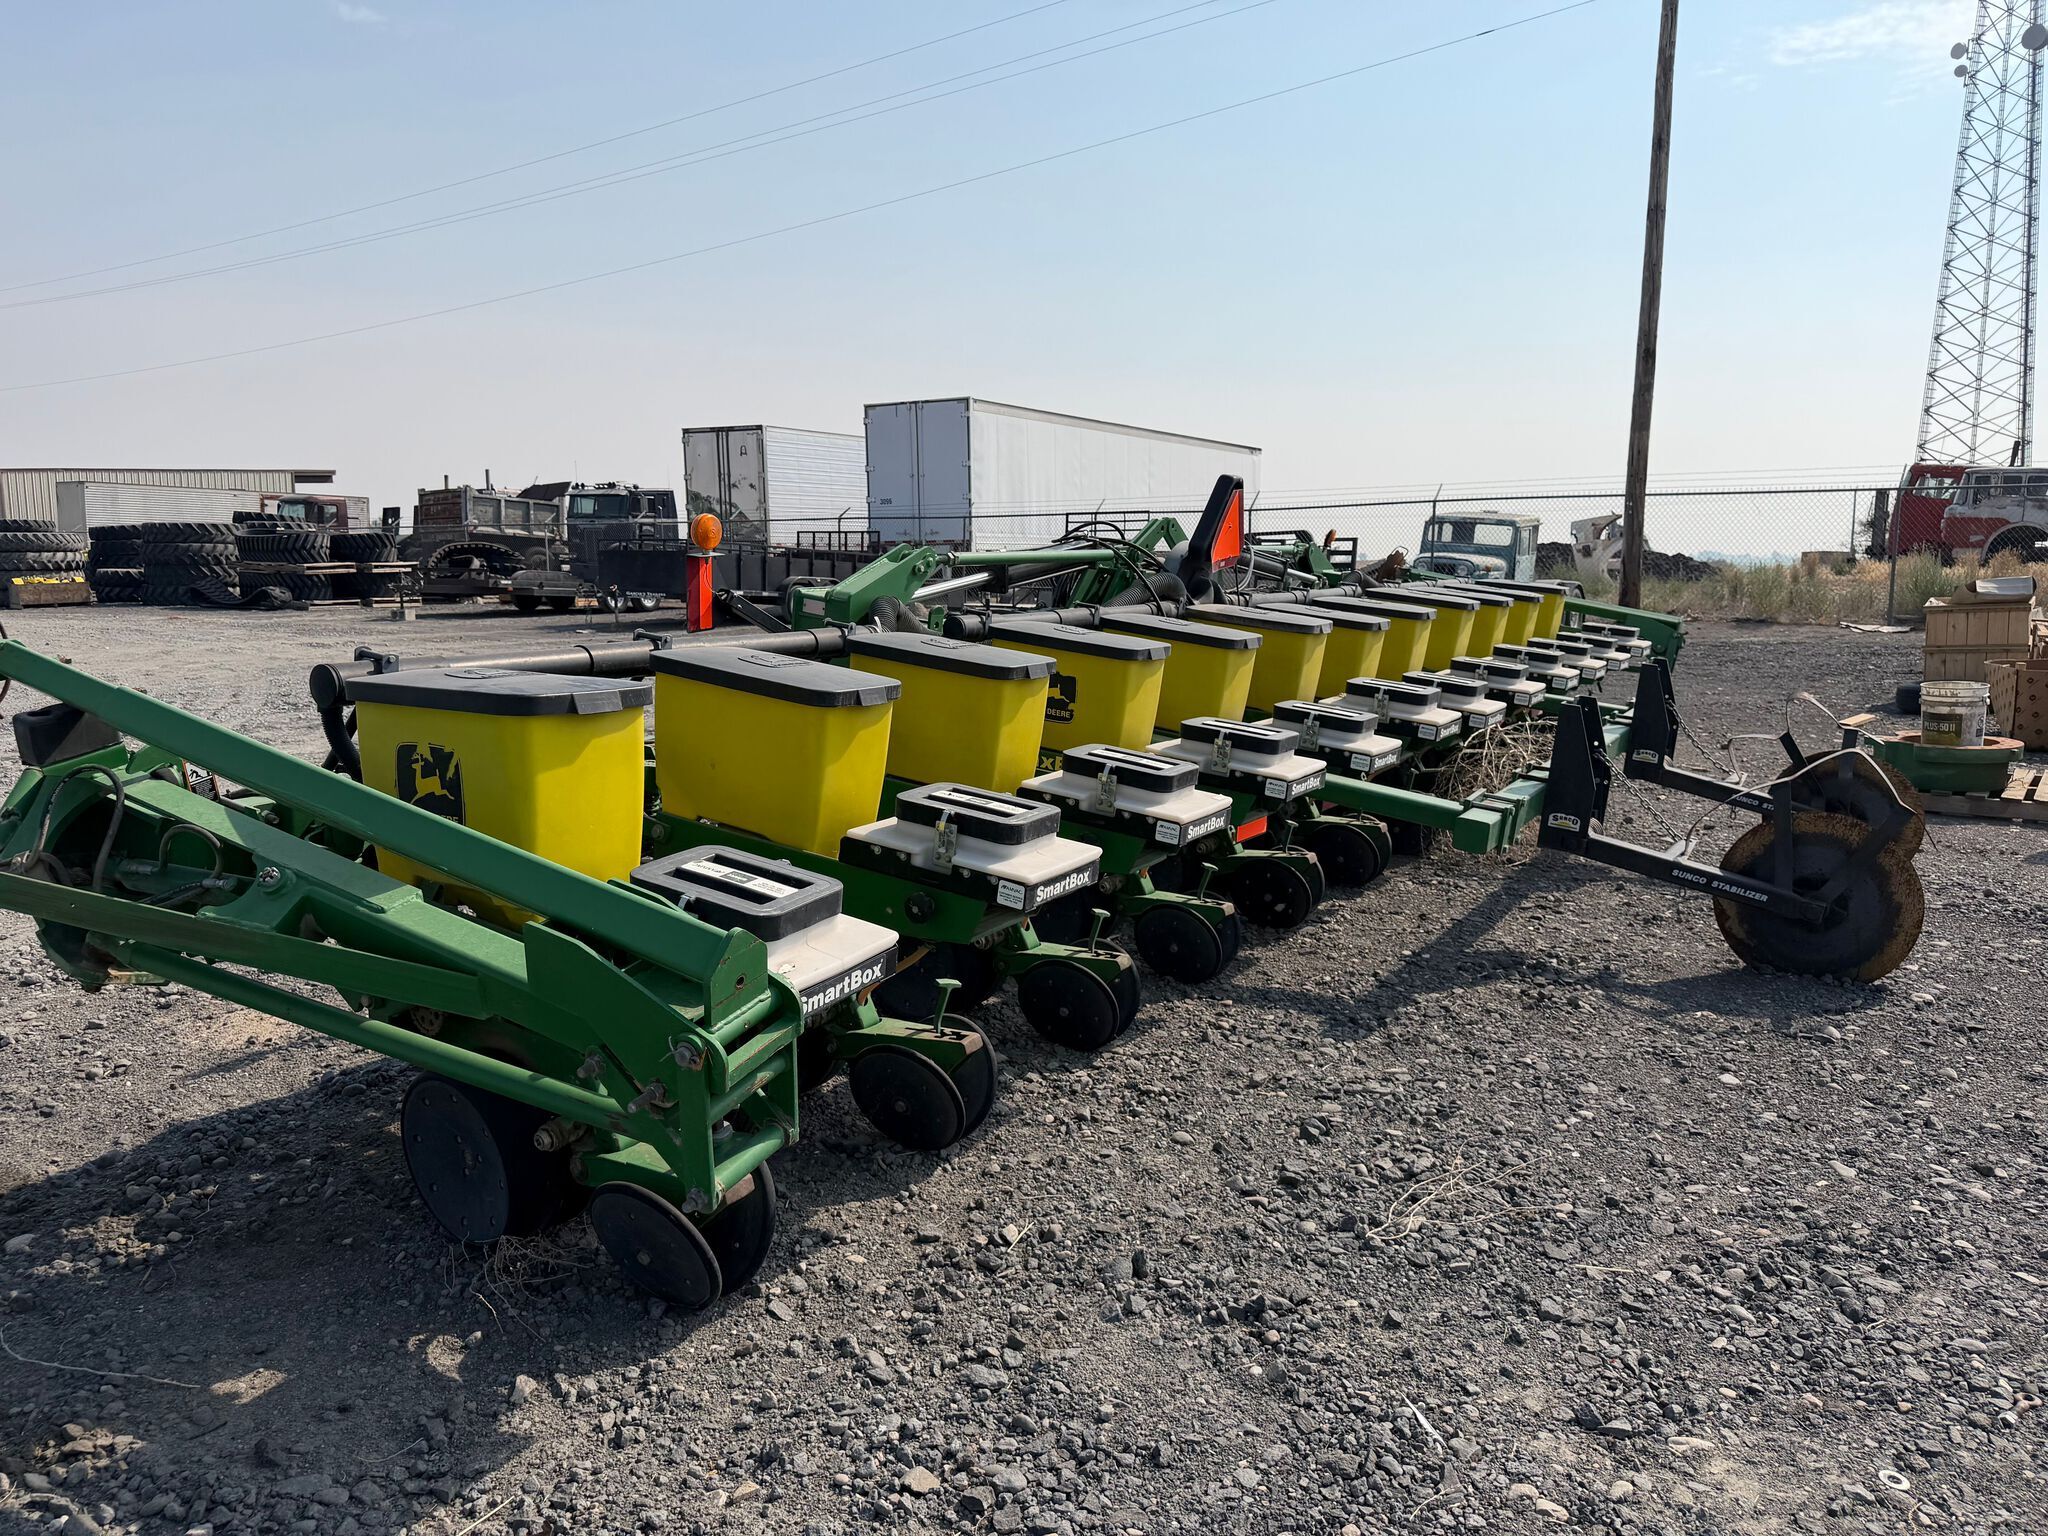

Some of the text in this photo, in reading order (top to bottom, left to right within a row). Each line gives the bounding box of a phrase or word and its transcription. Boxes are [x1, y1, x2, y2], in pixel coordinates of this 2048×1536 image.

[1046, 707, 1071, 718] DEERE
[1291, 777, 1320, 795] SmartBox
[1732, 794, 1759, 806] UNCO
[1187, 816, 1225, 839] SmartBox
[1551, 814, 1579, 826] SUNCO
[1036, 871, 1090, 902] SmartBox
[1671, 869, 1769, 902] SUNCO STABILIZER
